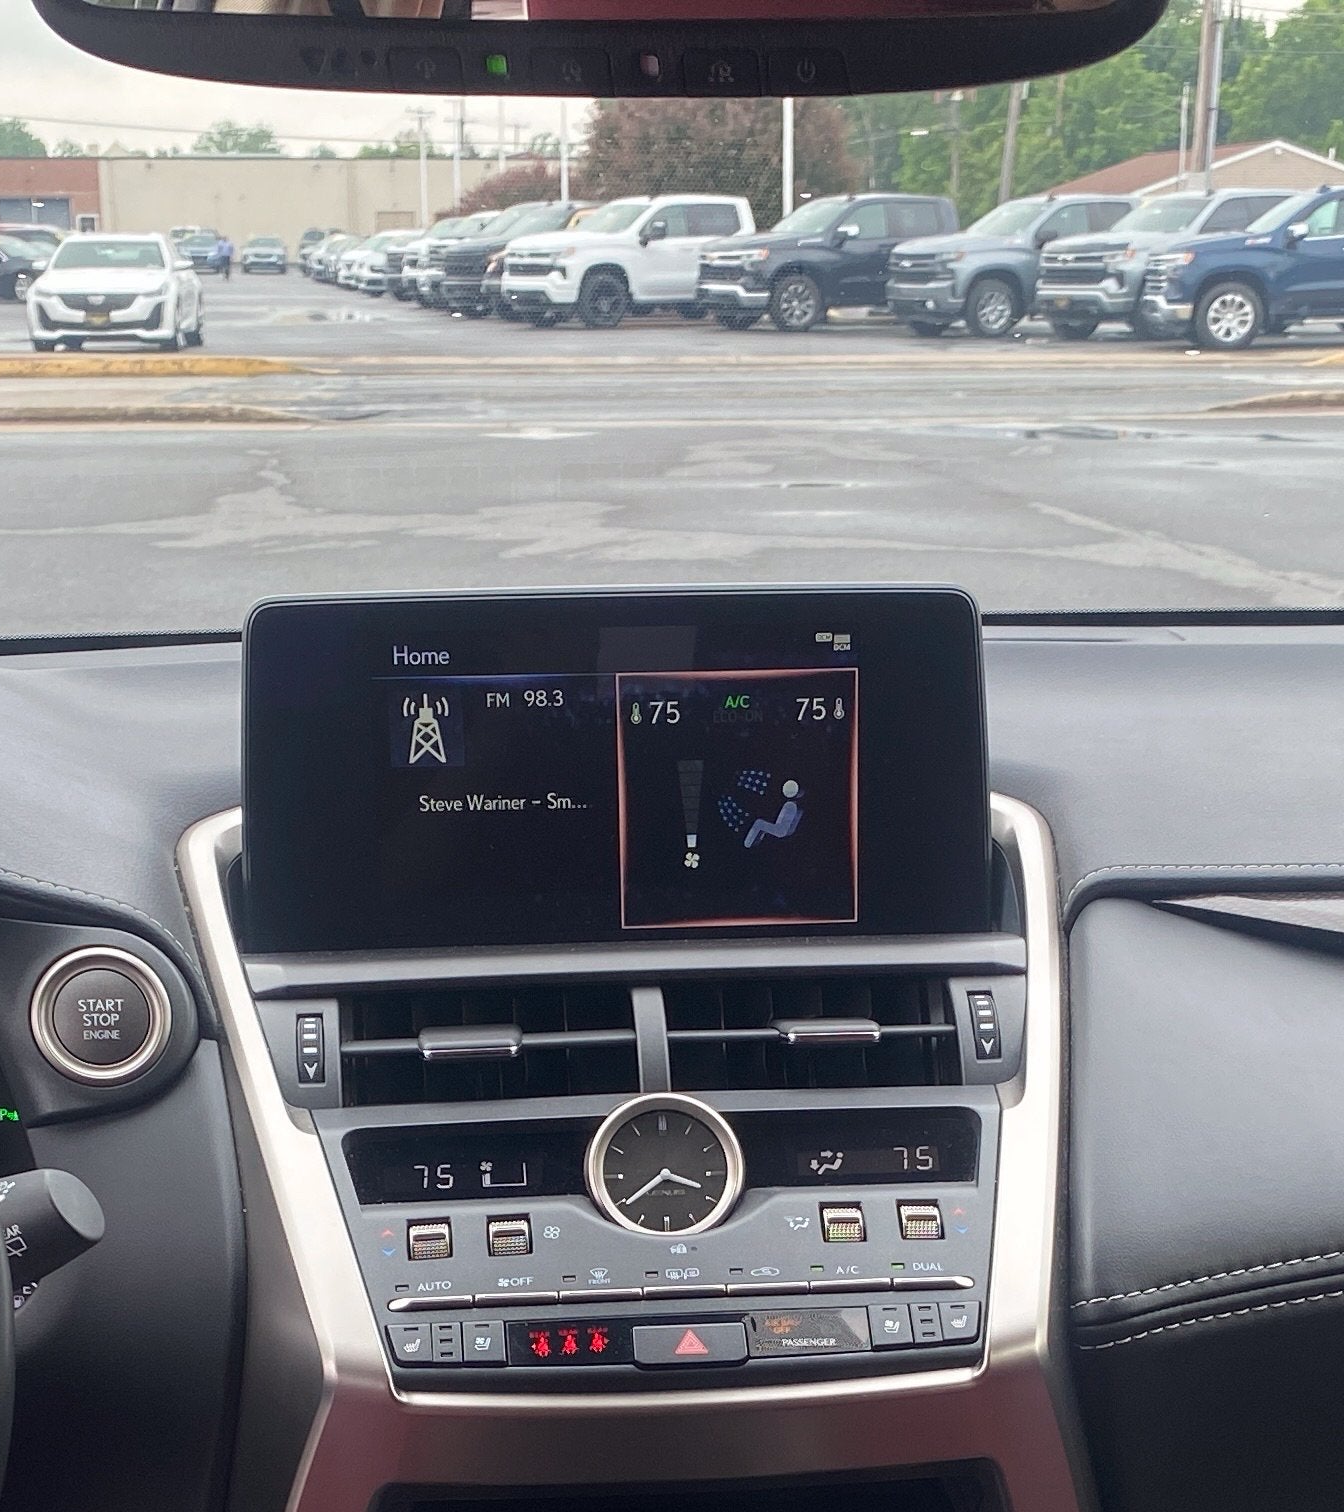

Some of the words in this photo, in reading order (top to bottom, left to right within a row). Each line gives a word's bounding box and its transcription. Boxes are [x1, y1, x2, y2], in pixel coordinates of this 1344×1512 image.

[392, 646, 450, 667] Home
[486, 692, 511, 708] FM
[523, 690, 564, 709] 98.3
[724, 695, 751, 709] A/C
[649, 700, 681, 726] 75
[796, 697, 827, 721] 75
[419, 795, 462, 813] Steve
[466, 794, 526, 812] Wariner
[77, 998, 125, 1012] START
[82, 1013, 120, 1027] STOP
[83, 1029, 121, 1041] ENGINE
[892, 1145, 933, 1171] 75
[413, 1164, 454, 1189] 75
[836, 1265, 860, 1275] A/C
[912, 1262, 944, 1272] DUAL
[417, 1280, 452, 1292] AUTO
[510, 1276, 535, 1287] OFF
[782, 1337, 837, 1347] PASSENGER
